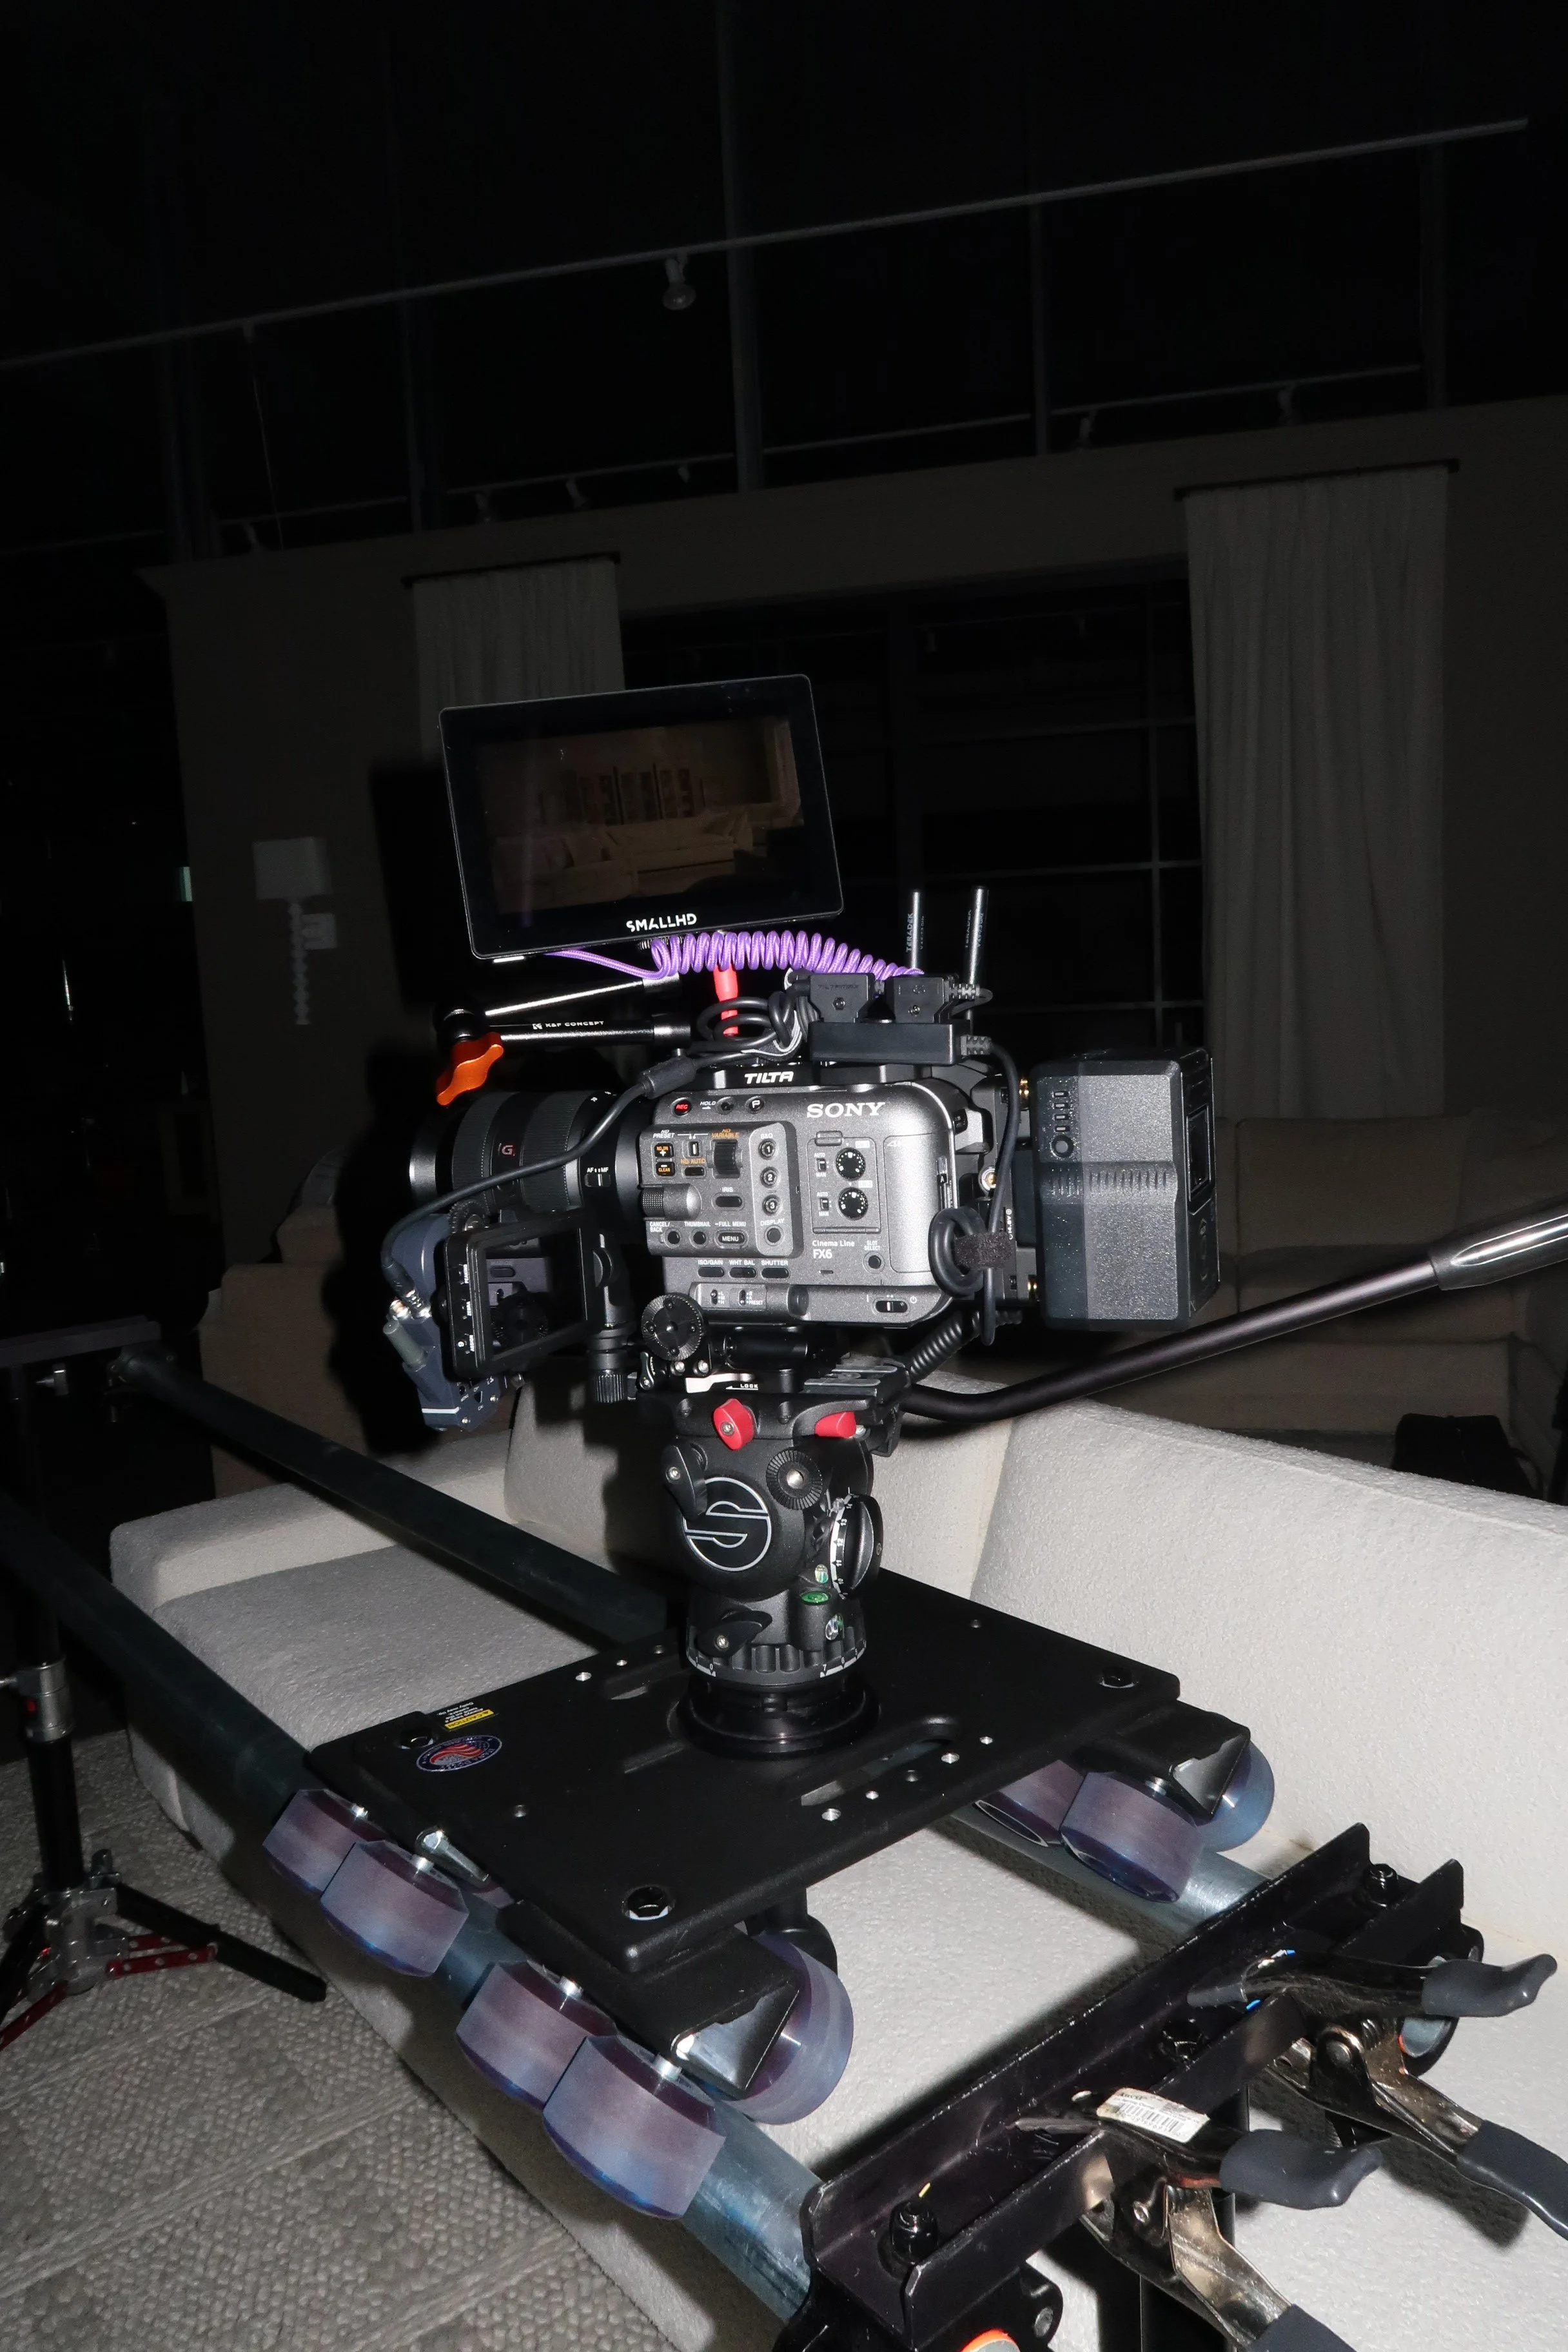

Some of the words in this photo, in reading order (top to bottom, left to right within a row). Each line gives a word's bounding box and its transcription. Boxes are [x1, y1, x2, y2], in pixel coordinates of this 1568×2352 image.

[626, 913, 697, 932] SMALLHD
[744, 1071, 794, 1084] TILTA
[752, 1100, 761, 1108] P
[807, 1102, 886, 1118] SONY
[501, 1144, 514, 1155] G
[760, 1218, 785, 1226] DISPLAY
[813, 1249, 833, 1259] FX6
[840, 1518, 848, 1527] 13
[837, 1538, 844, 1547] 12
